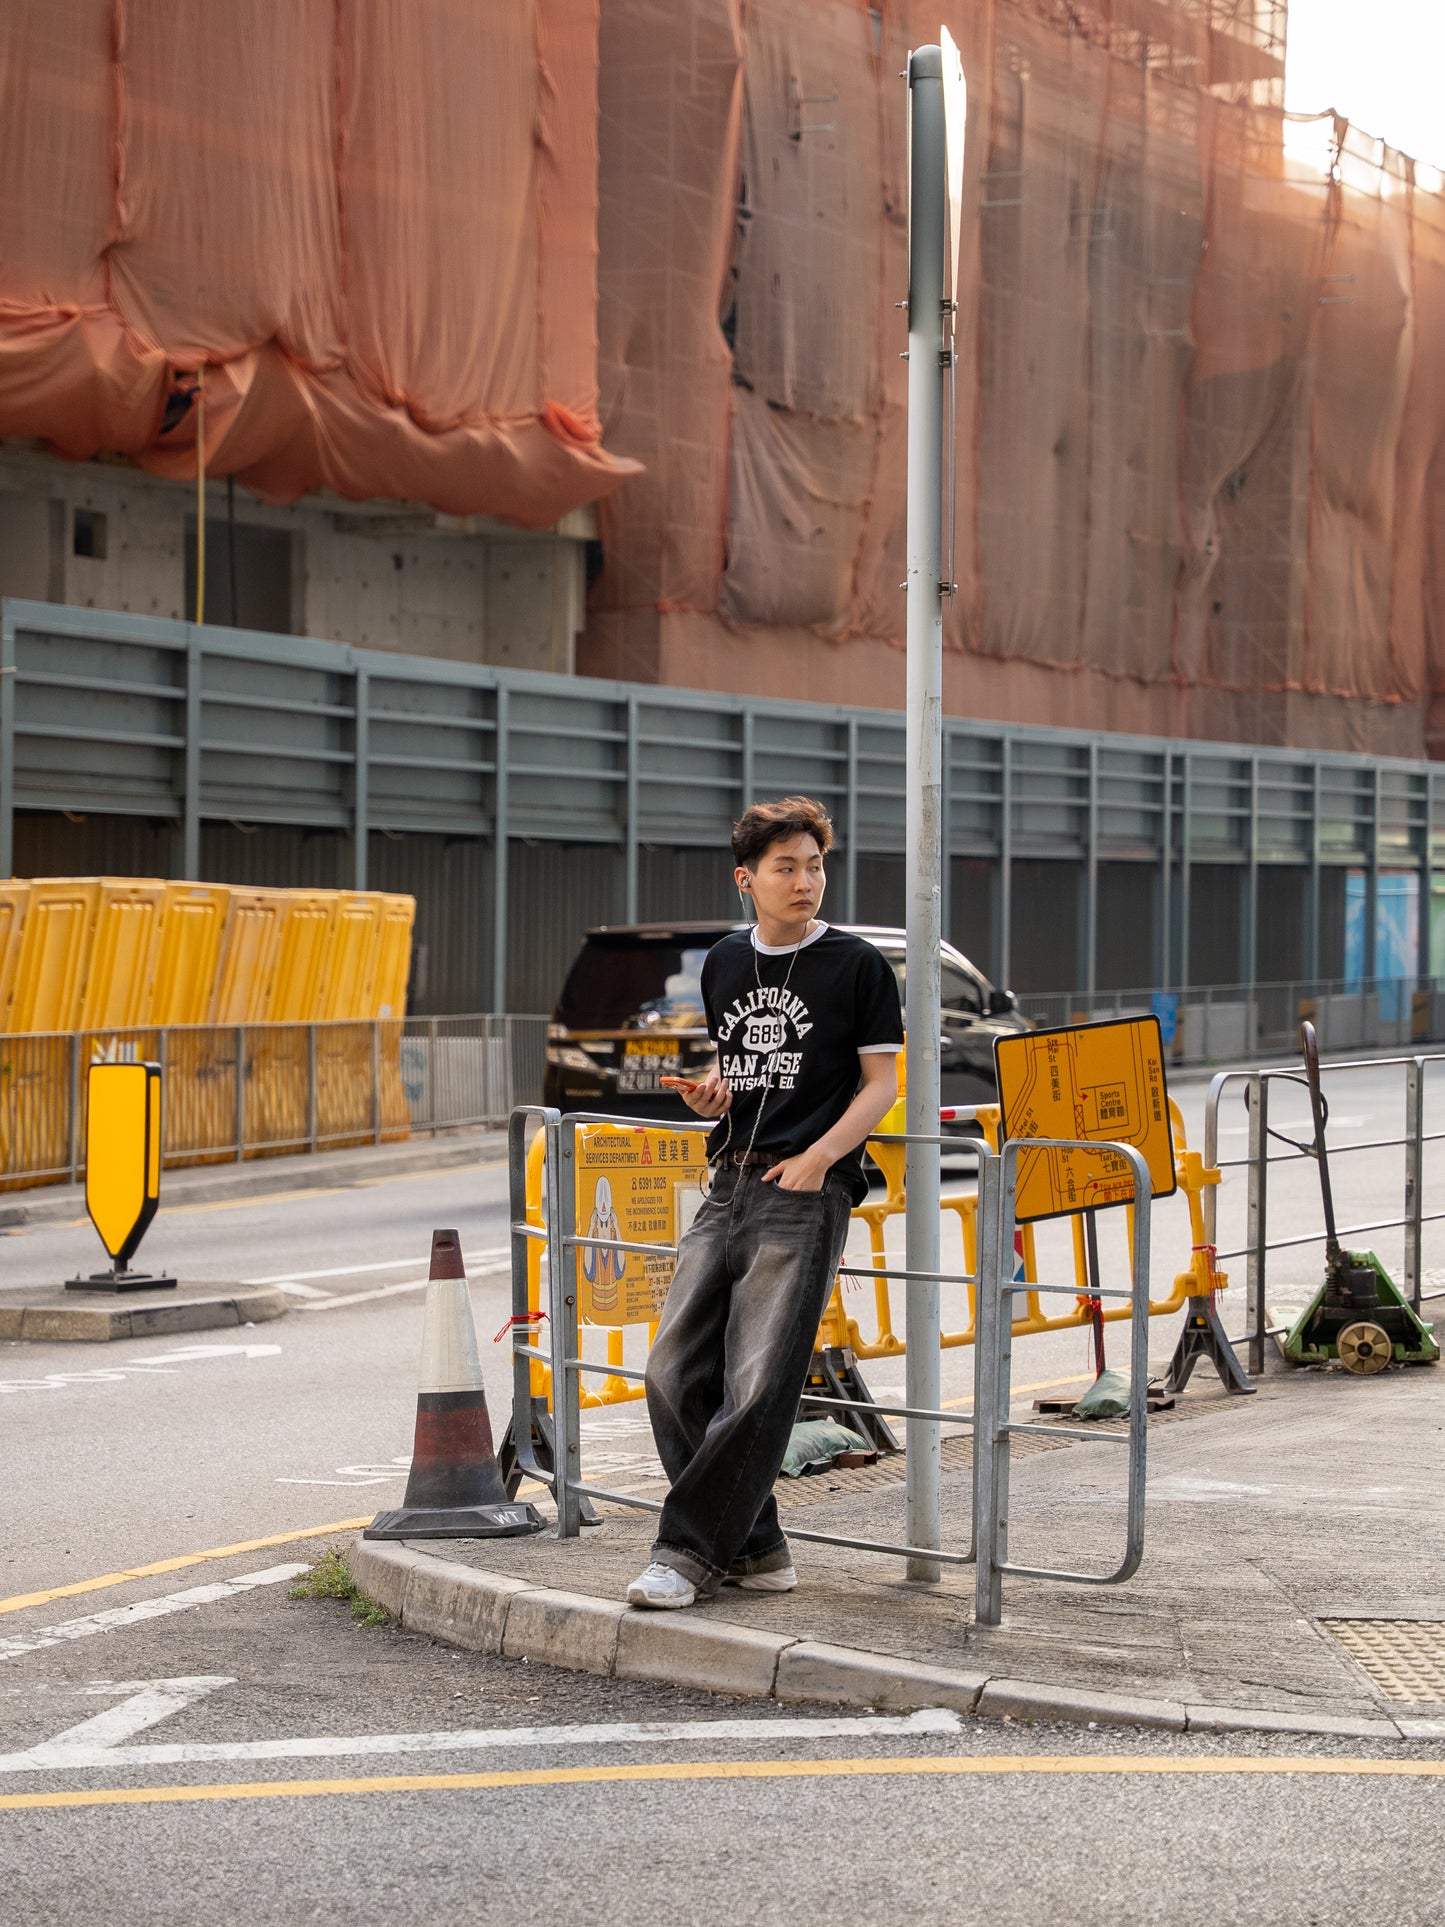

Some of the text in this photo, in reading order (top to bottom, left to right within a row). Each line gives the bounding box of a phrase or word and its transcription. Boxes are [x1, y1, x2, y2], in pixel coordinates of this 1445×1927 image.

[718, 987, 814, 1042] CALIFORNIA
[750, 1024, 782, 1044] 689
[722, 1052, 802, 1076] SAN JOSE
[779, 1076, 795, 1090] ED.
[1050, 1065, 1061, 1102] 四美街
[1150, 1075, 1157, 1083] Rd
[1100, 1091, 1120, 1100] Sports
[1100, 1099, 1121, 1108] Centre
[1026, 1108, 1034, 1118] St
[1100, 1106, 1125, 1120] 體育館
[594, 1137, 631, 1147] ARCHITECTURAL
[658, 1139, 689, 1162] 建築署
[586, 1152, 639, 1164] SERVICES DEPARTMENT
[639, 1177, 666, 1190] 6391 3025
[493, 1510, 520, 1525] WT
